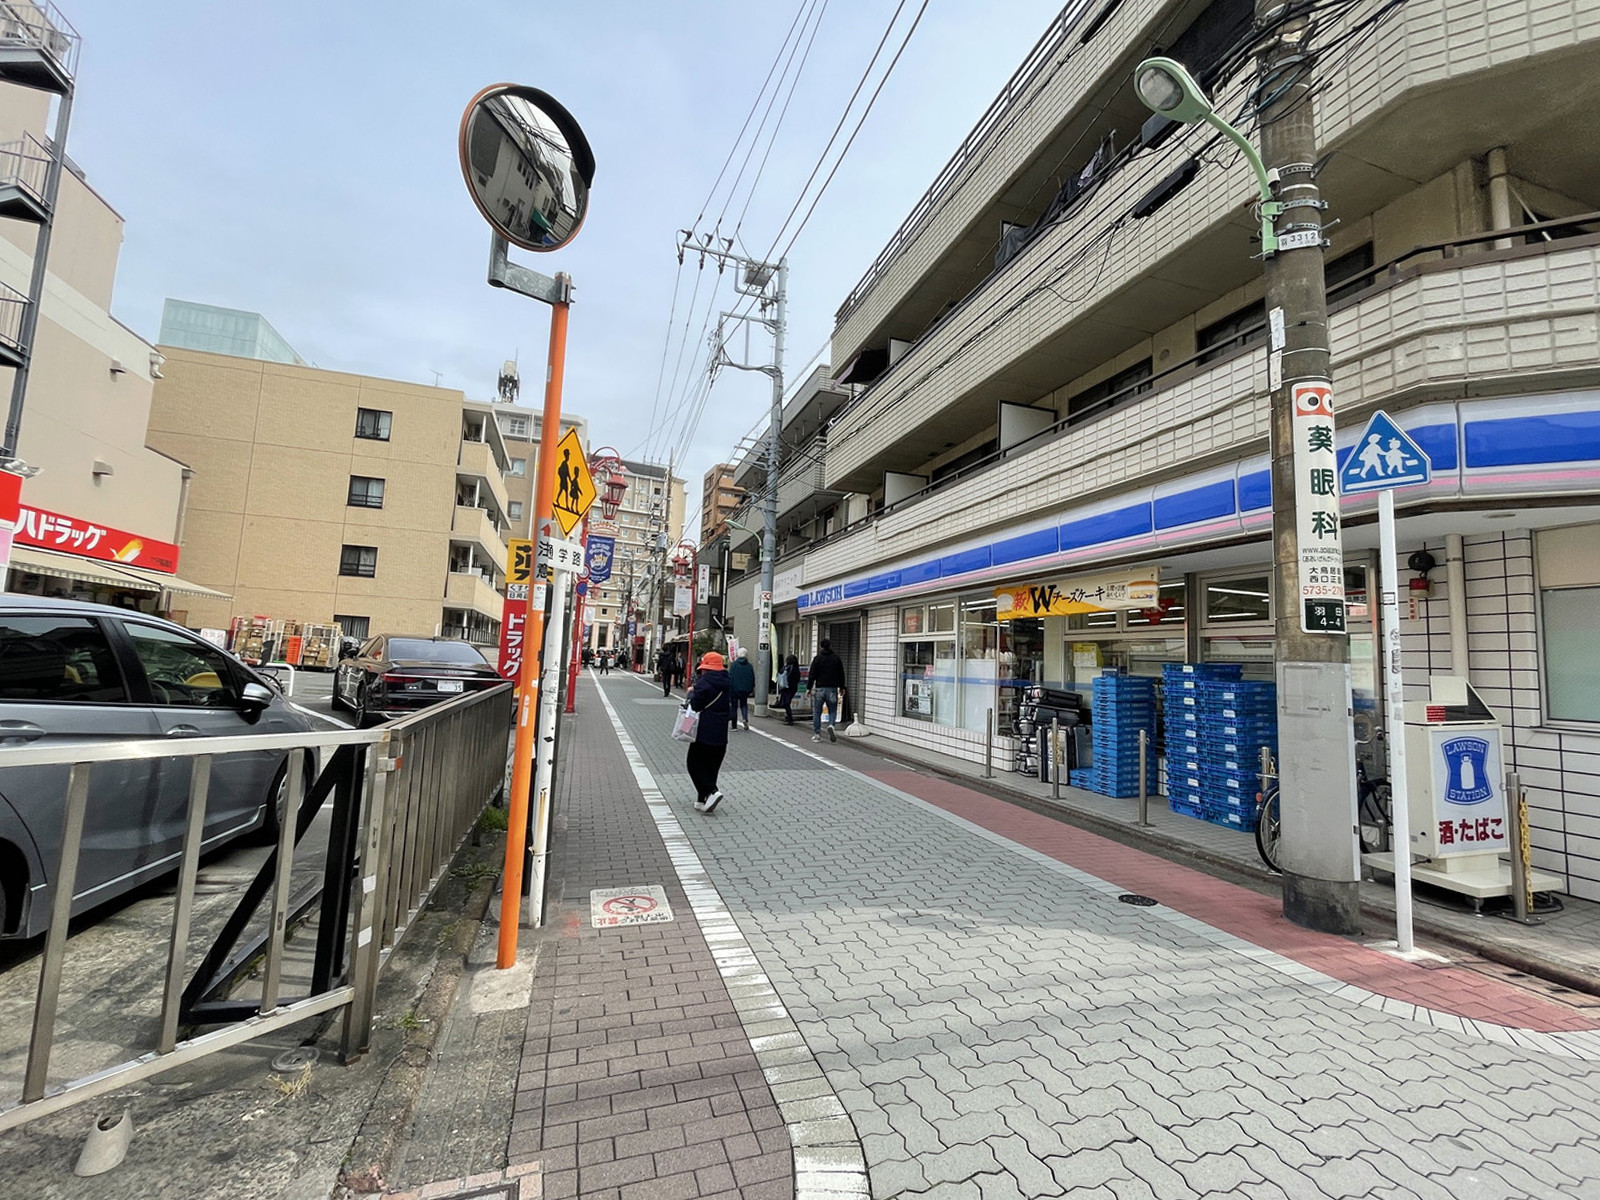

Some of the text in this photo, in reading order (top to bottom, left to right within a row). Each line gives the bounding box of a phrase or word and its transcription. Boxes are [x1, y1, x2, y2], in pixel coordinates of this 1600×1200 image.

[1290, 232, 1316, 242] 3312
[1307, 424, 1339, 541] 葵眼科
[13, 508, 107, 550] ハドラッグ
[810, 585, 842, 606] LAWSON
[503, 612, 527, 678] ドラッグ
[1446, 741, 1485, 755] LAWSON
[1449, 787, 1488, 801] STATION
